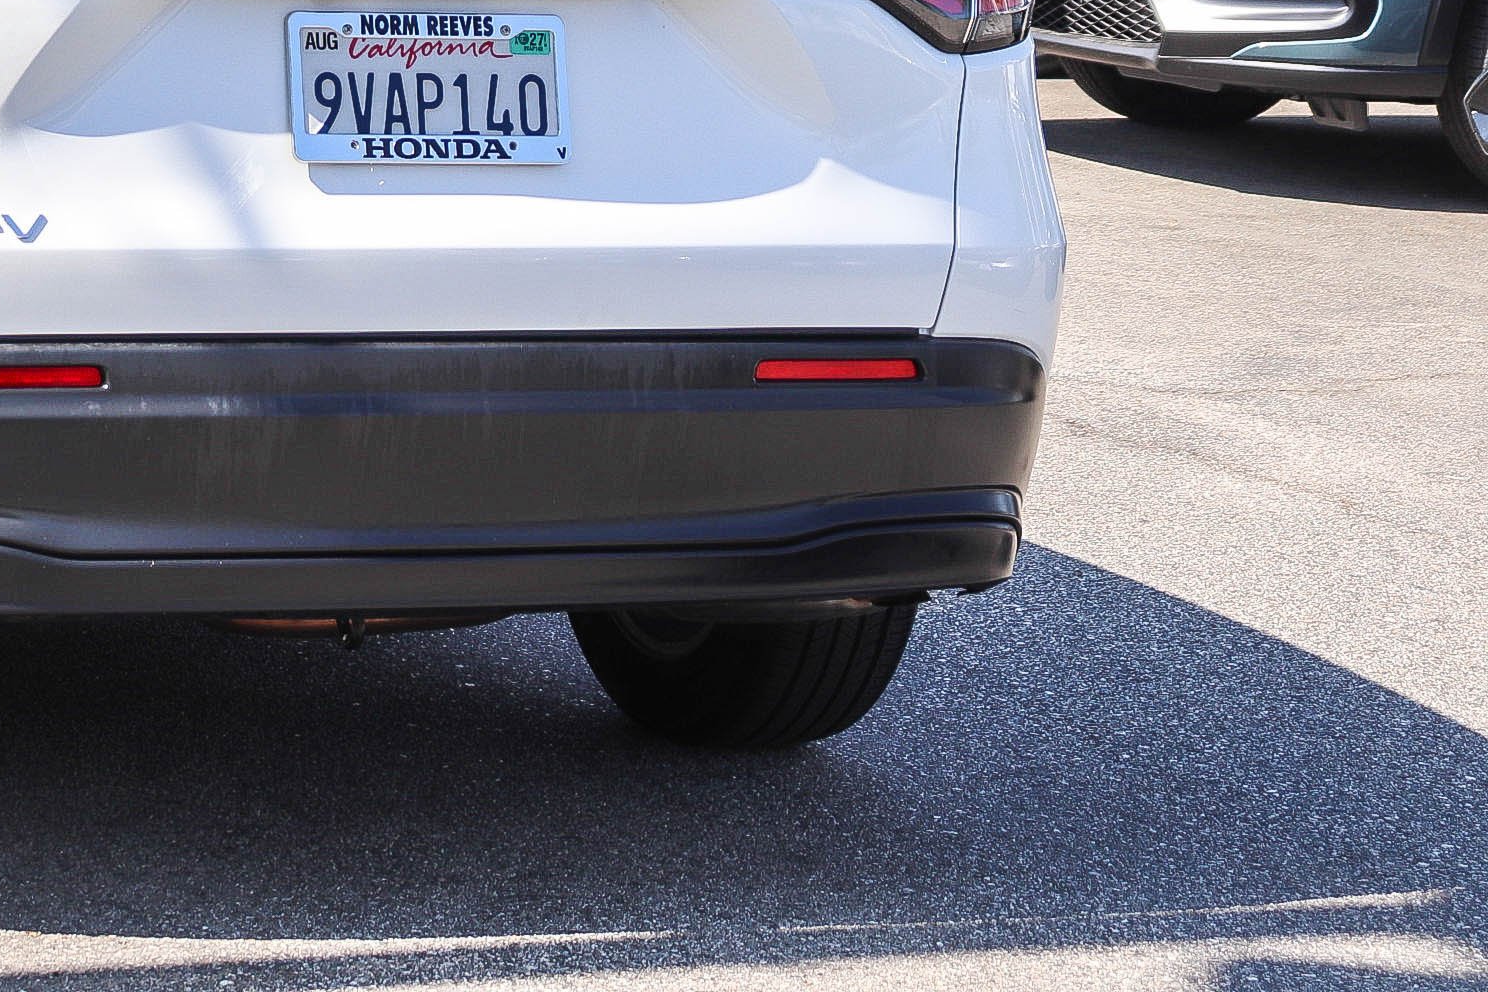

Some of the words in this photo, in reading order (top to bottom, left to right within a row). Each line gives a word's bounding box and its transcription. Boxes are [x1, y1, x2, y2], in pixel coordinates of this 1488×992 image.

[360, 14, 420, 36] NORM
[427, 15, 494, 37] REEVES
[304, 31, 339, 50] AUG
[348, 37, 513, 69] California
[313, 71, 548, 136] 9VAP140
[361, 137, 512, 159] HONDA
